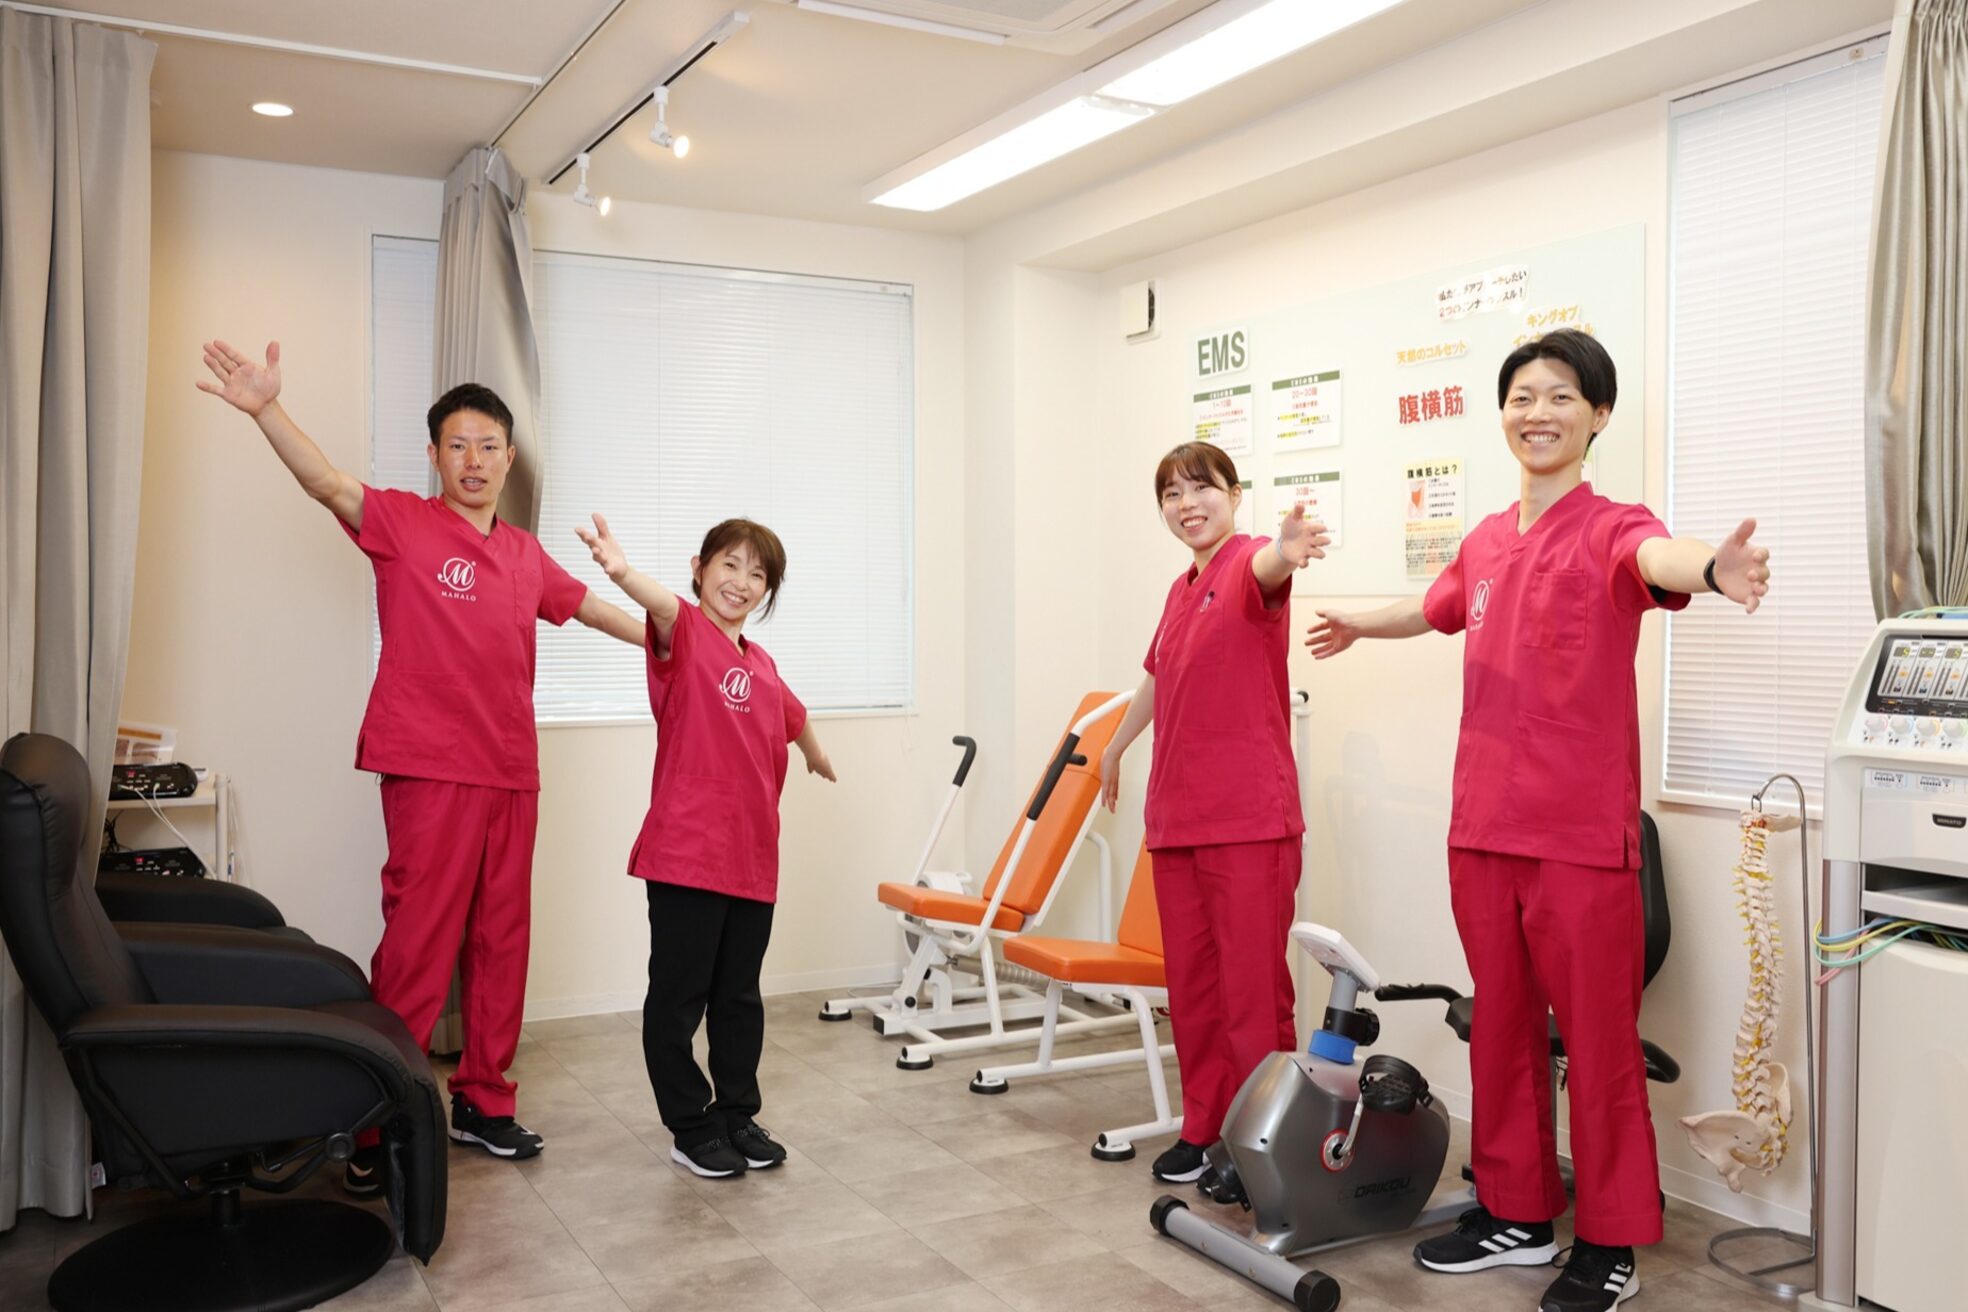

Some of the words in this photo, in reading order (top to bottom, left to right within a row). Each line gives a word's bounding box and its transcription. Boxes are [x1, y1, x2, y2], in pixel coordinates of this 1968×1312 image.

[1197, 330, 1246, 376] EMS
[1398, 385, 1463, 424] 腹横筋
[441, 590, 477, 602] MAHALO
